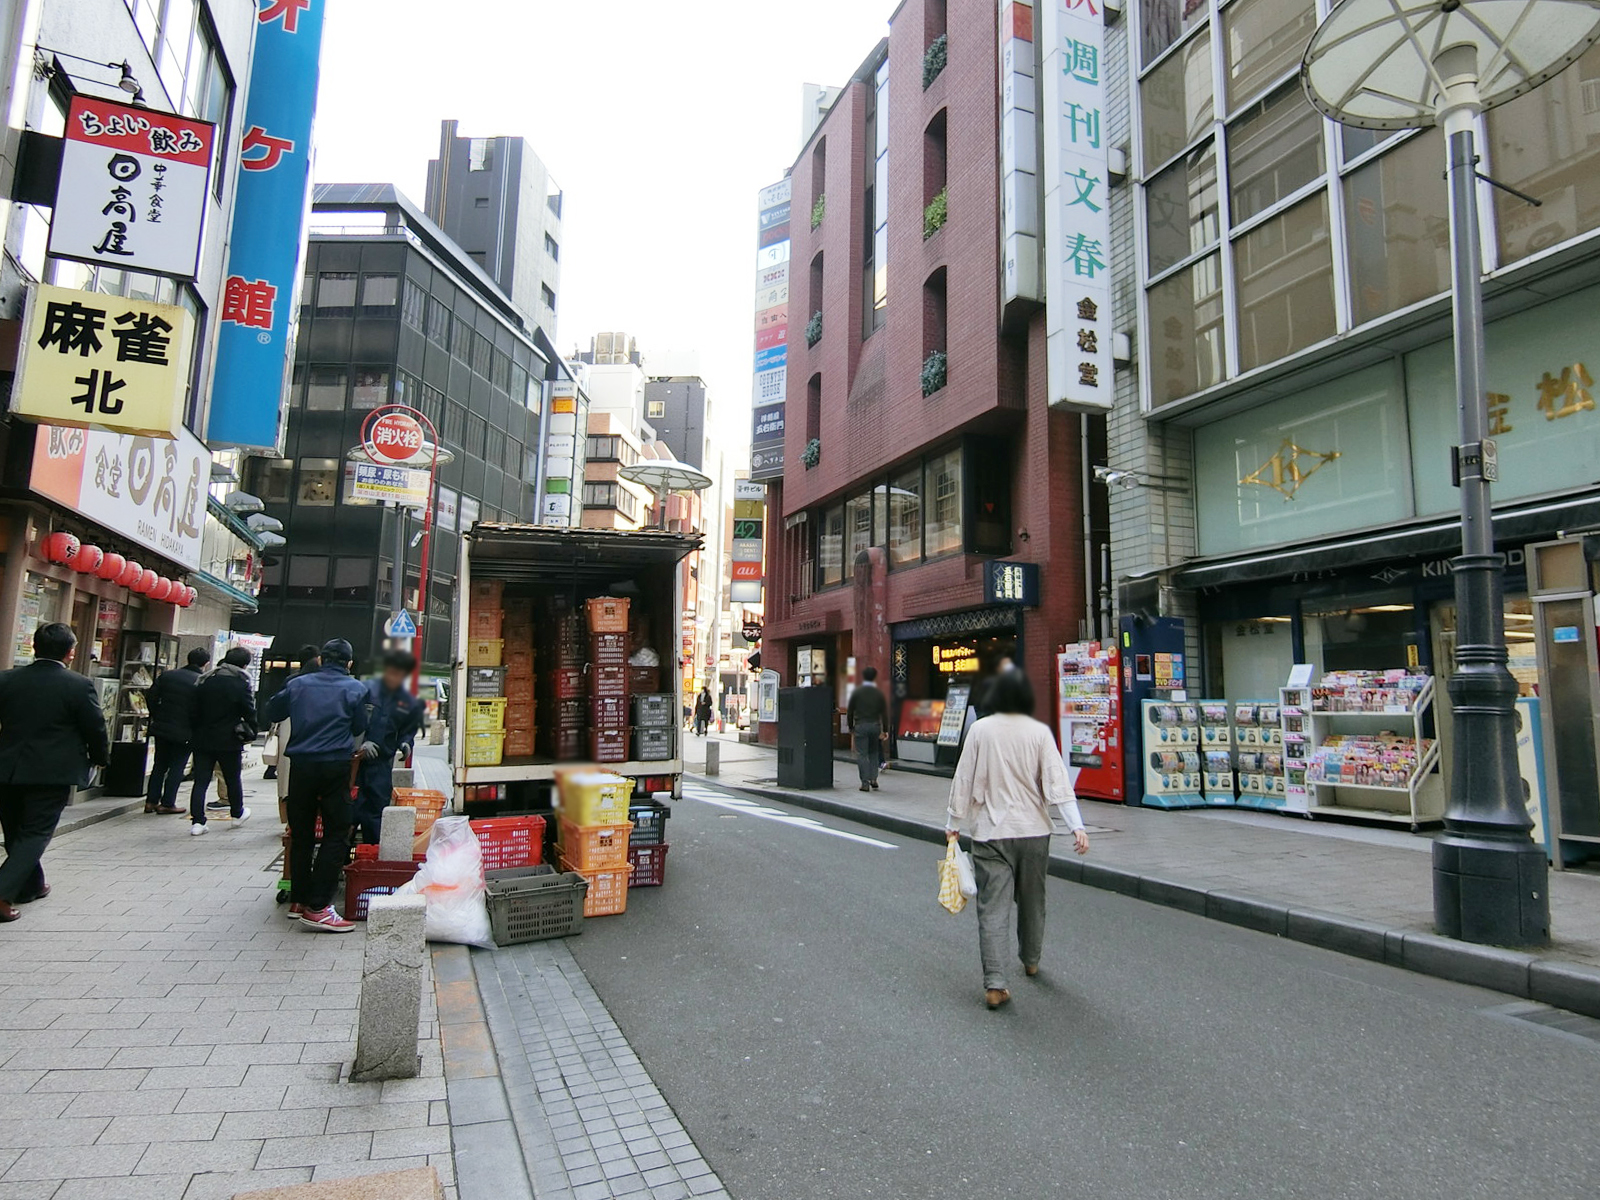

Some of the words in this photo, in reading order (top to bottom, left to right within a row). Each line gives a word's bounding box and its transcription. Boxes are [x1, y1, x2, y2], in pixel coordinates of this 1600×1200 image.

[80, 112, 204, 154] ちょい飲み
[1061, 35, 1108, 280] 週刊文春
[93, 153, 142, 257] 日高屋
[147, 162, 168, 224] 中華食堂
[38, 301, 174, 366] 麻雀
[1076, 296, 1099, 388] 金松堂
[71, 368, 128, 415] 北
[48, 425, 84, 460] 飲み
[376, 426, 420, 448] 消火栓
[137, 520, 157, 543] RAMEN
[161, 534, 184, 556] HIDAKAYA
[735, 520, 756, 539] 42
[737, 567, 758, 575] au
